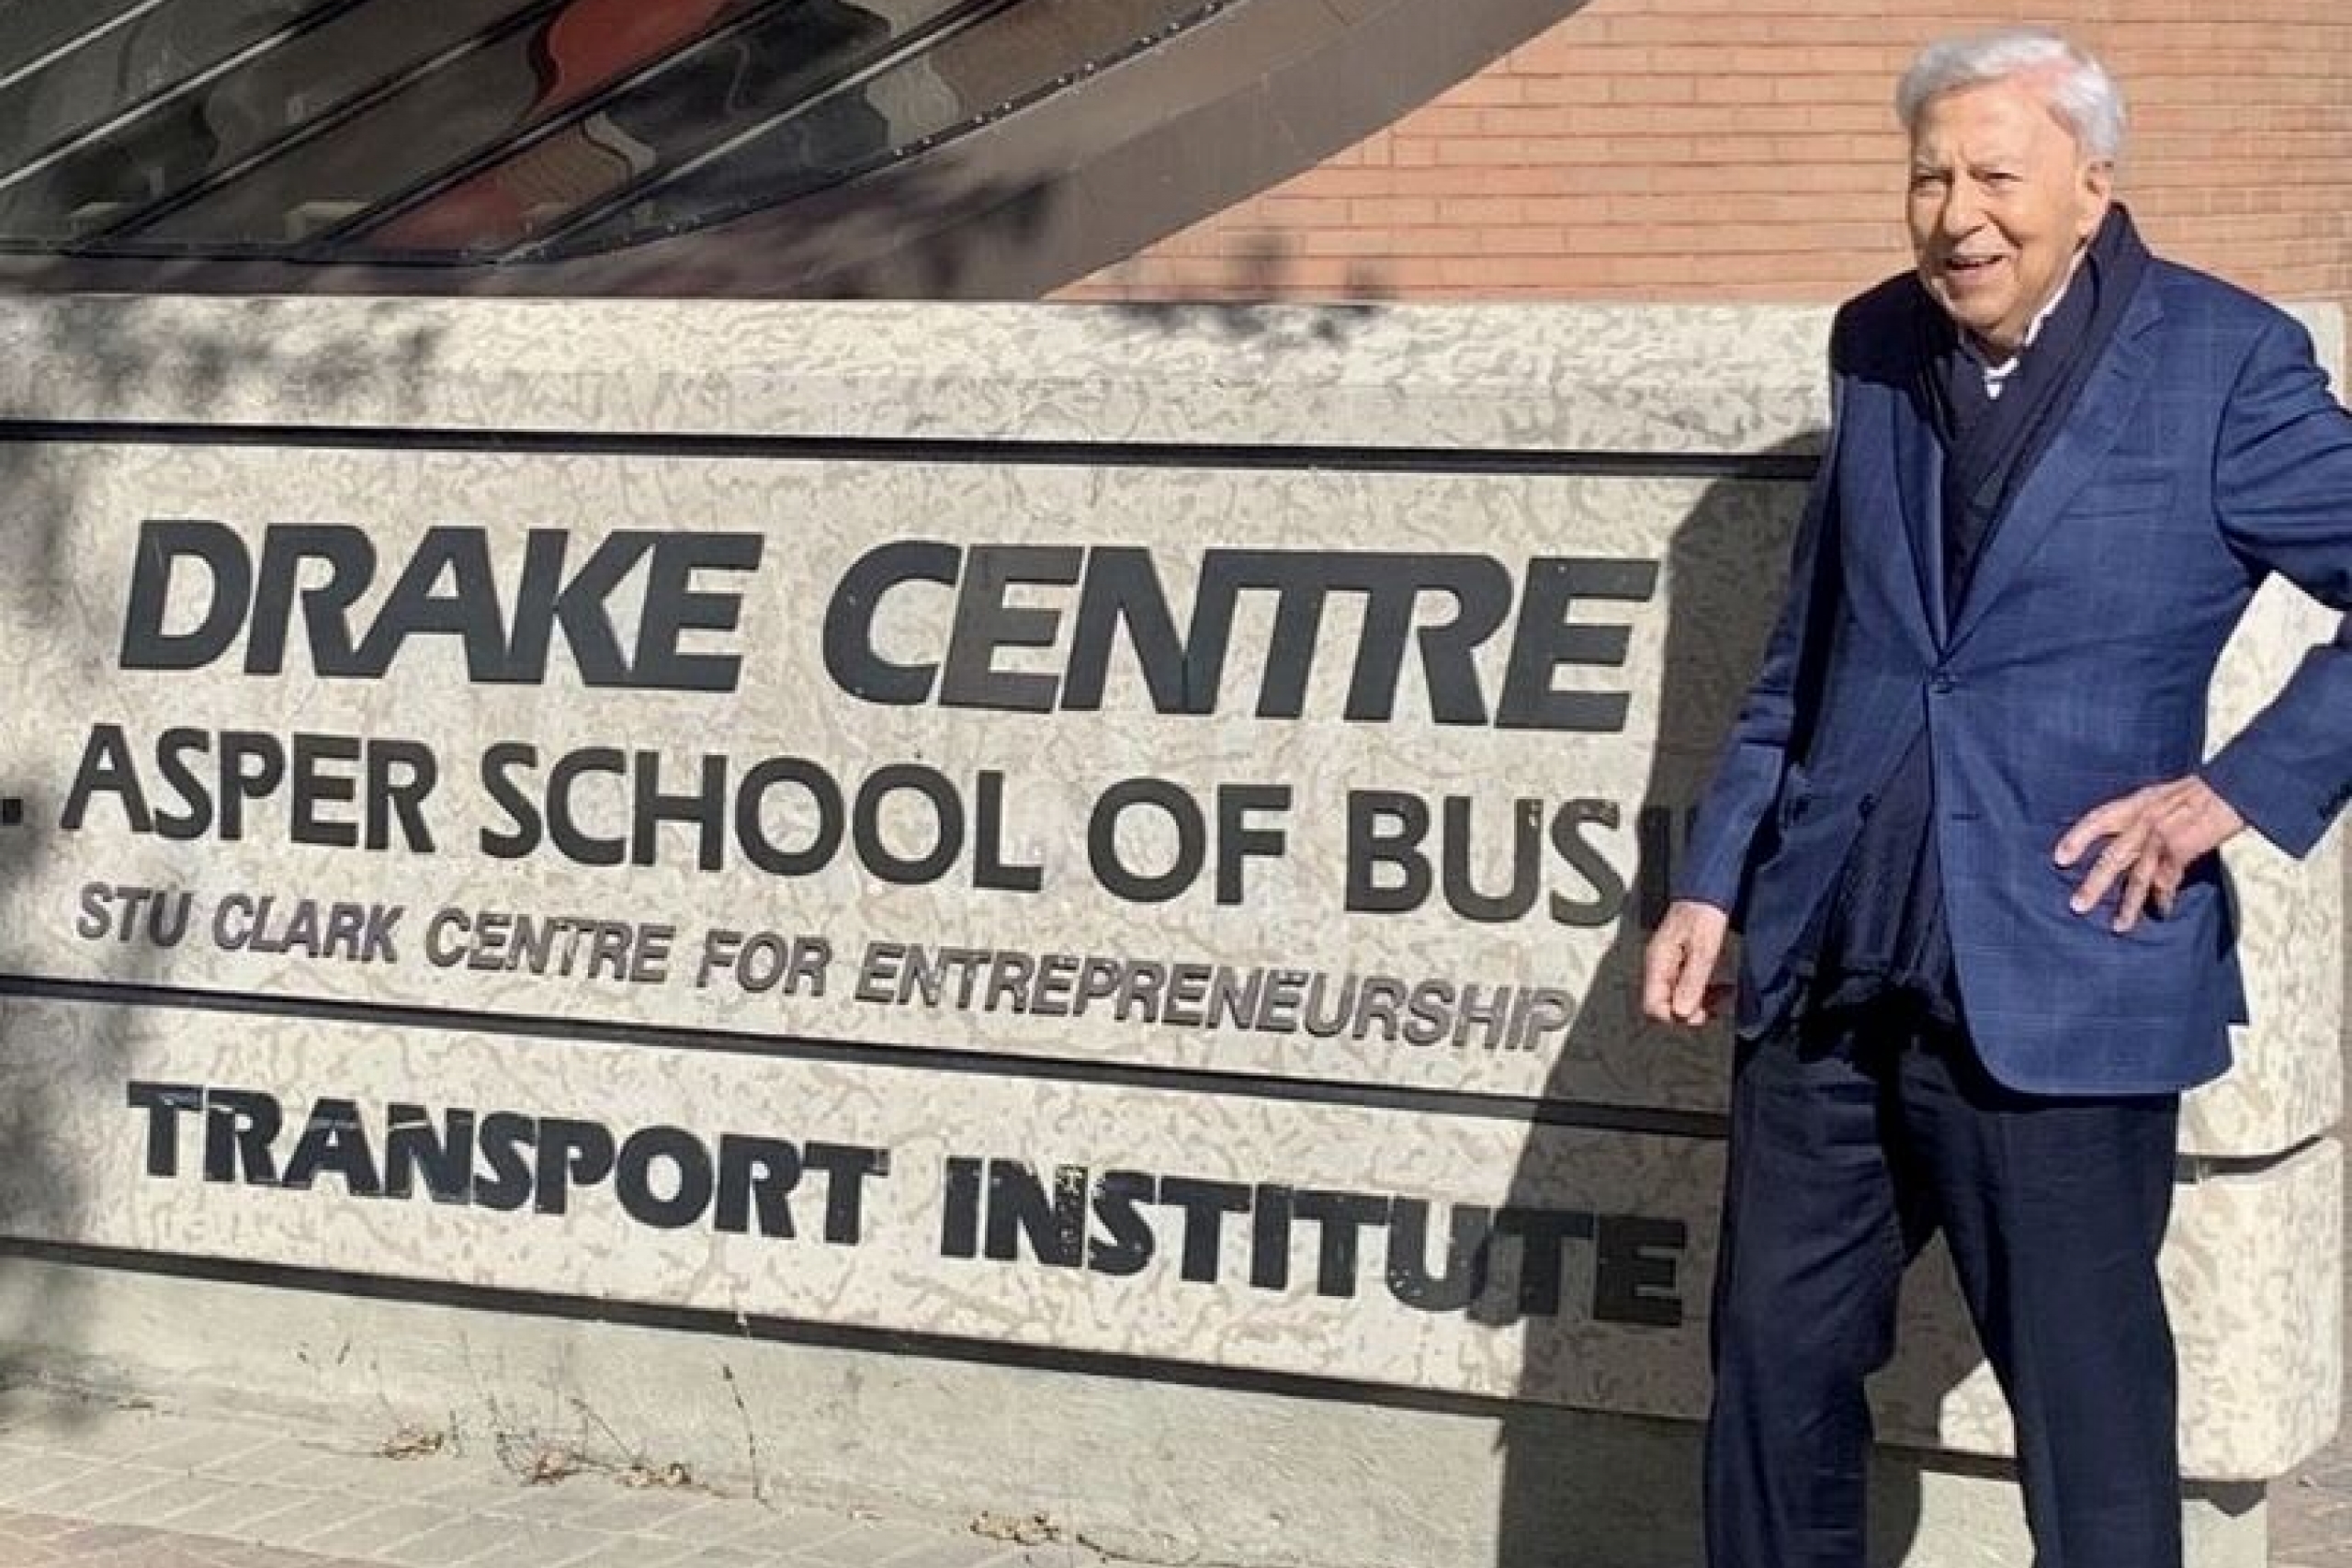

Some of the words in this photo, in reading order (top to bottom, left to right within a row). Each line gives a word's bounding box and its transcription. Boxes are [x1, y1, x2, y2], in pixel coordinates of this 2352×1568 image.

[119, 519, 764, 691] DRAKE
[822, 539, 1660, 732] CENTRE
[61, 722, 436, 852] ASPER
[480, 742, 1043, 891] SCHOOL
[1087, 777, 1292, 904] OF
[1345, 790, 1696, 931] BUSI
[76, 882, 194, 947] STU
[212, 893, 404, 963] CLARK
[425, 907, 676, 983] CENTRE
[696, 929, 831, 998] FOR
[855, 942, 1576, 1054] ENTREPRENEURSHIP
[127, 1081, 891, 1245] TRANSPORT
[940, 1156, 1689, 1328] INSTITUTE
